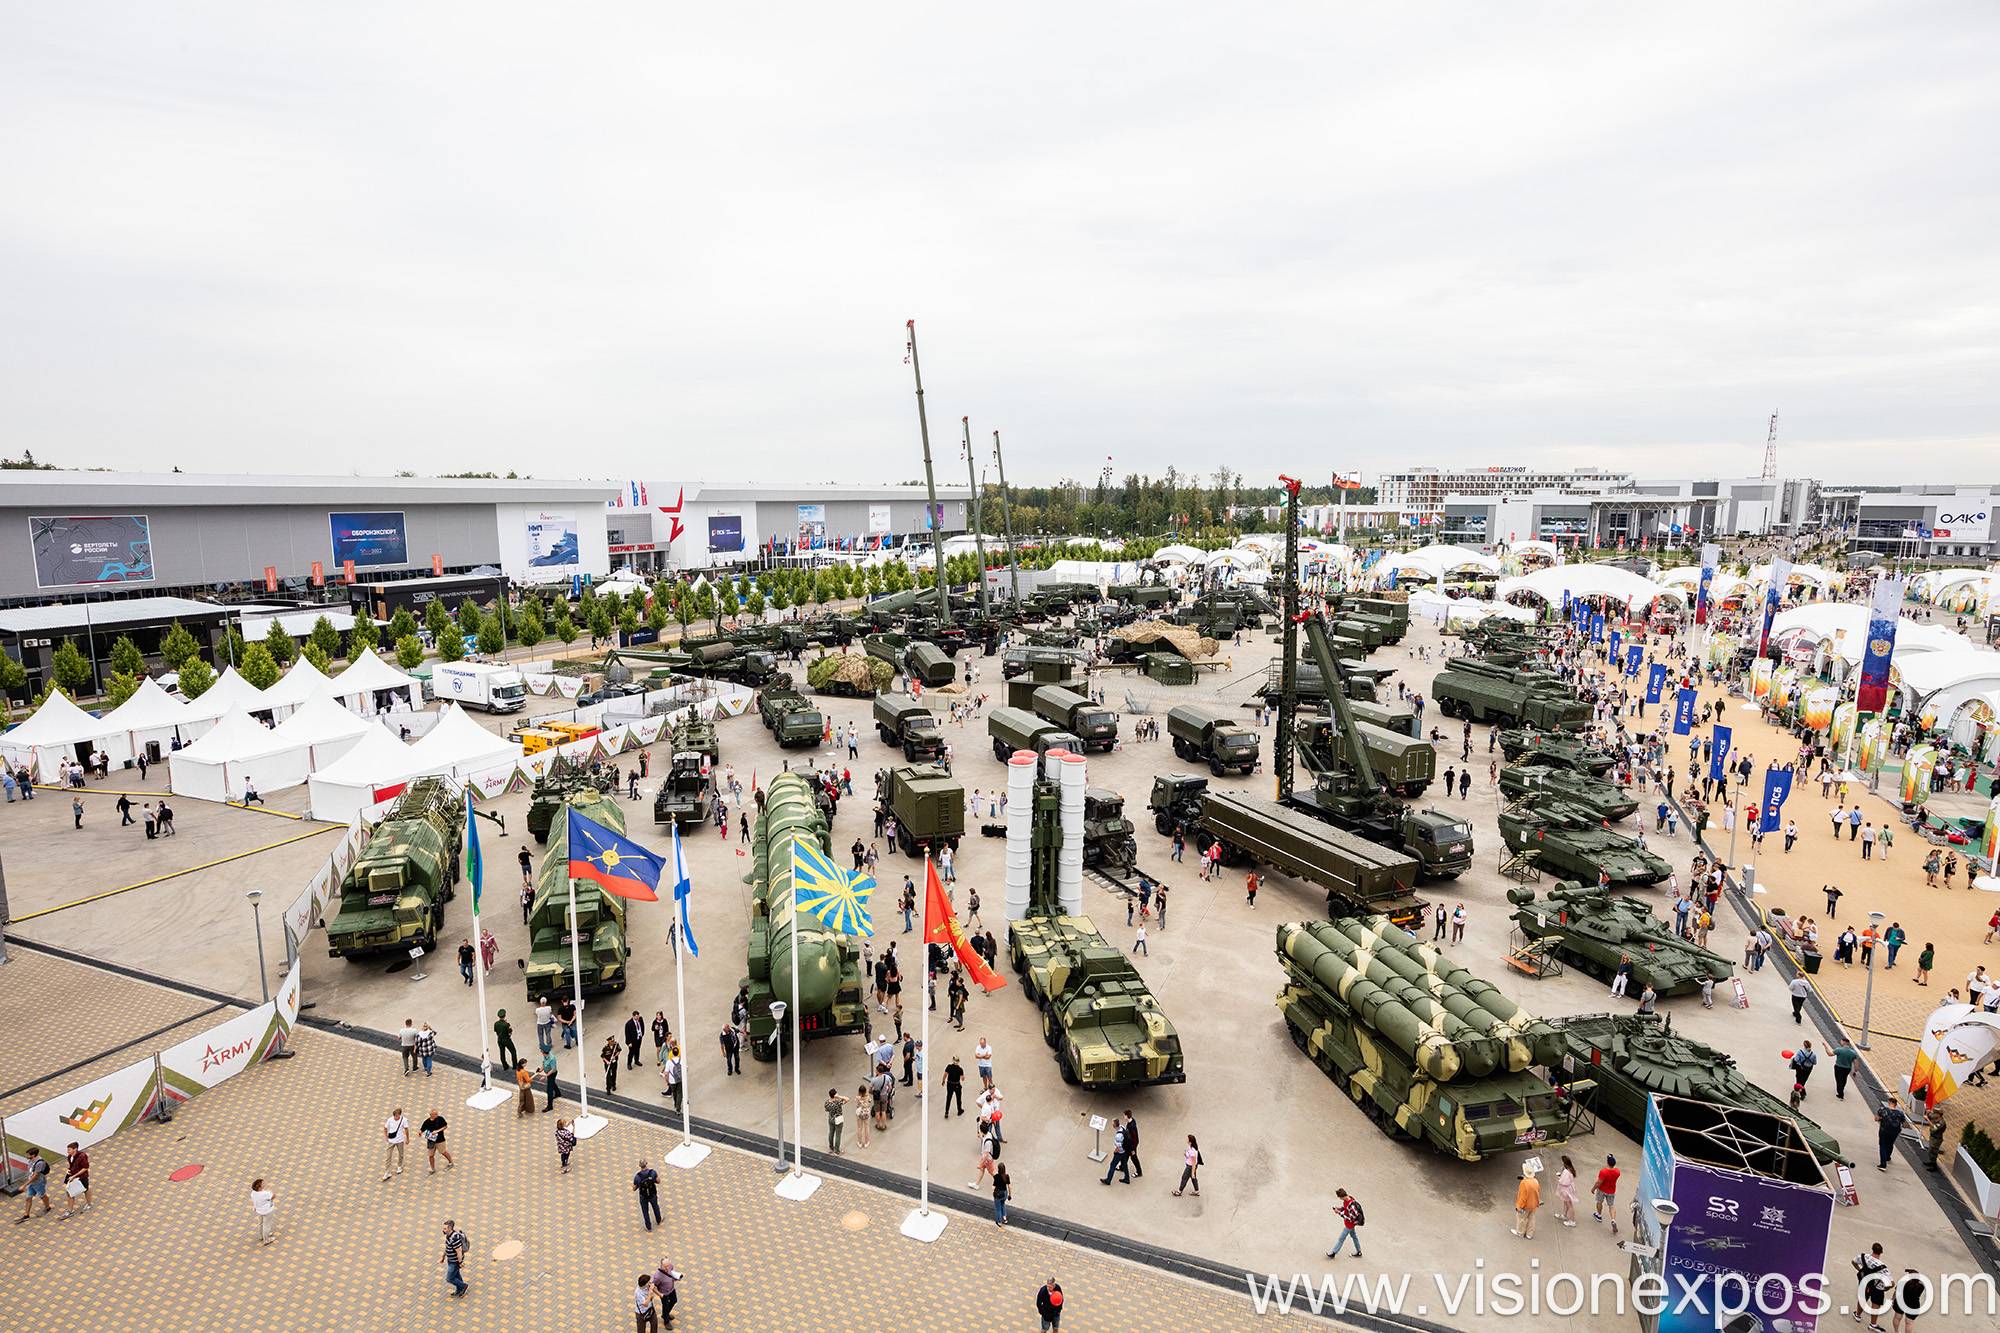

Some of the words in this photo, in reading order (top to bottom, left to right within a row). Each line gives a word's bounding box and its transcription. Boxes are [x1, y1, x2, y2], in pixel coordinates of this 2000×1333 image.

[608, 545, 635, 553] ПАТРИОТ
[637, 543, 656, 551] ЭКСПО
[1682, 700, 1690, 715] ПСБ
[1719, 739, 1727, 756] ПСБ
[485, 776, 508, 790] ARMY
[1771, 786, 1782, 805] ПСБ
[200, 1037, 253, 1074] ARMY
[1707, 1196, 1740, 1216] SR
[1705, 1211, 1738, 1222] space
